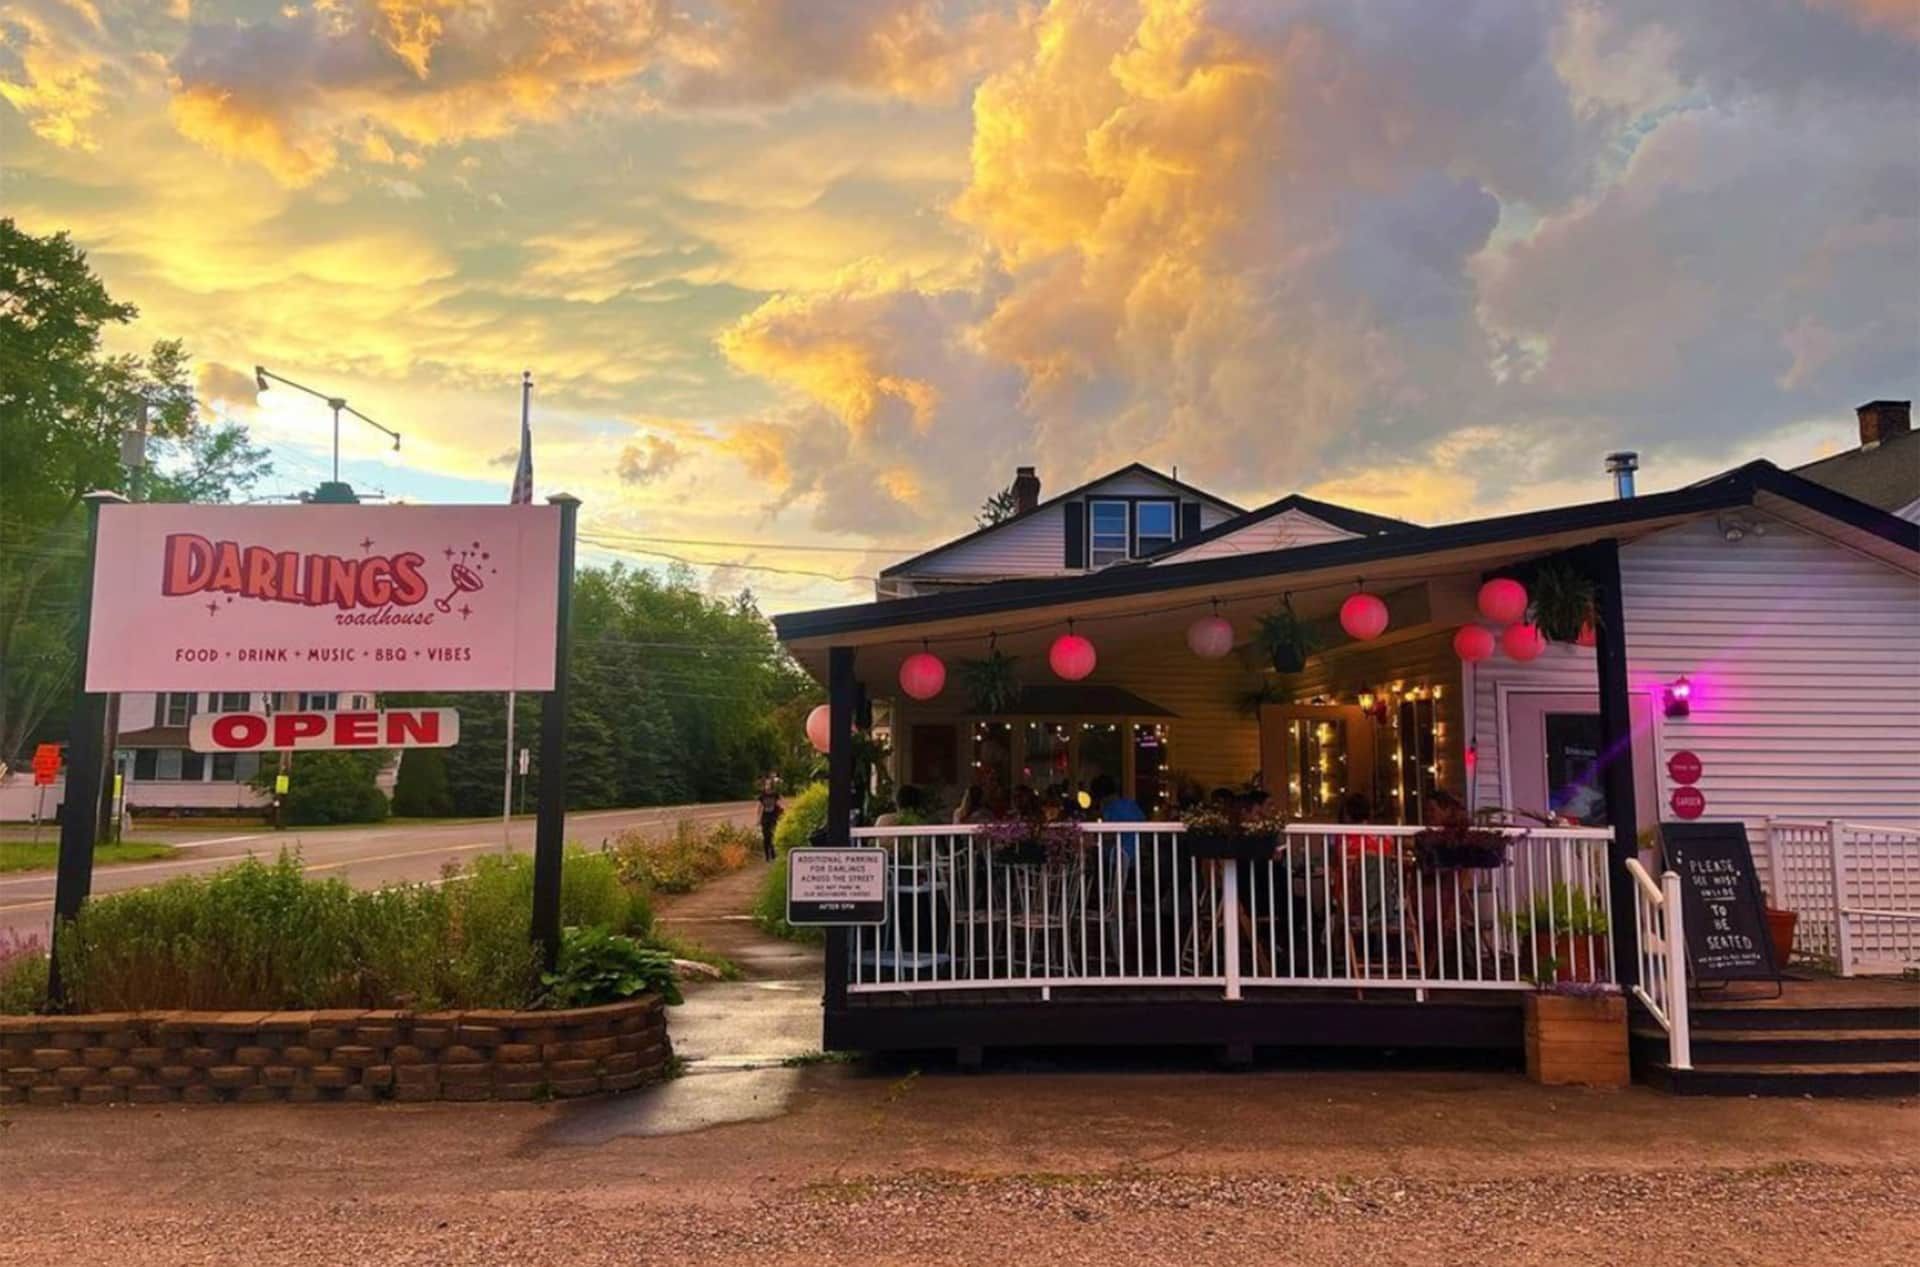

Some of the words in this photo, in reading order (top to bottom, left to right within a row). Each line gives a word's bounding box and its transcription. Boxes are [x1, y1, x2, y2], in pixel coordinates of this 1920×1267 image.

[162, 533, 428, 609] DARLINGS
[336, 605, 434, 626] roadhouse
[175, 648, 218, 662] FOOD
[238, 648, 288, 662] DRINK
[307, 648, 355, 662] MUSIC
[375, 648, 407, 661] BBQ
[427, 647, 472, 661] VIBES
[211, 711, 440, 749] OPEN
[1710, 904, 1728, 917] TO
[1713, 918, 1731, 931] BE
[1706, 935, 1753, 950] SEATED
